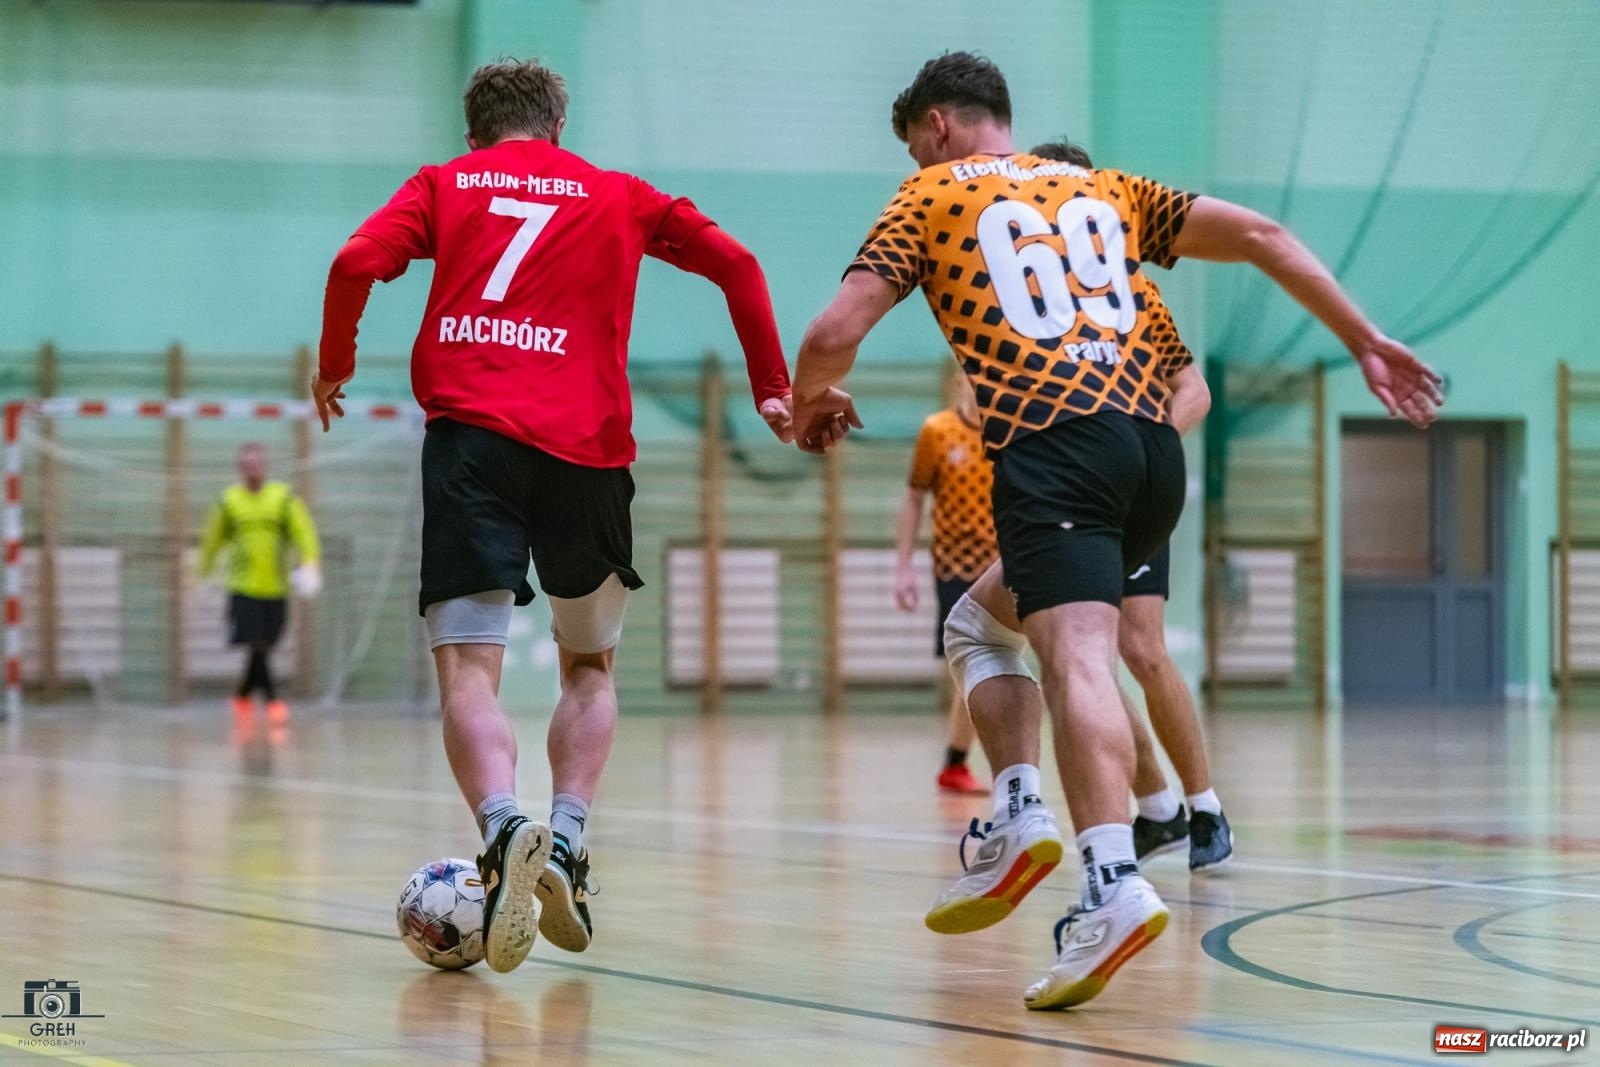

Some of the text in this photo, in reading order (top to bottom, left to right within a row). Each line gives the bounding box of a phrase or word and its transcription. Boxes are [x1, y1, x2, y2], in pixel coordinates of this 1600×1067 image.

[456, 171, 589, 198] BRAUN-MEBEL
[481, 196, 560, 302] 7
[976, 197, 1137, 340] 69
[439, 315, 568, 356] RACIBÓRZ
